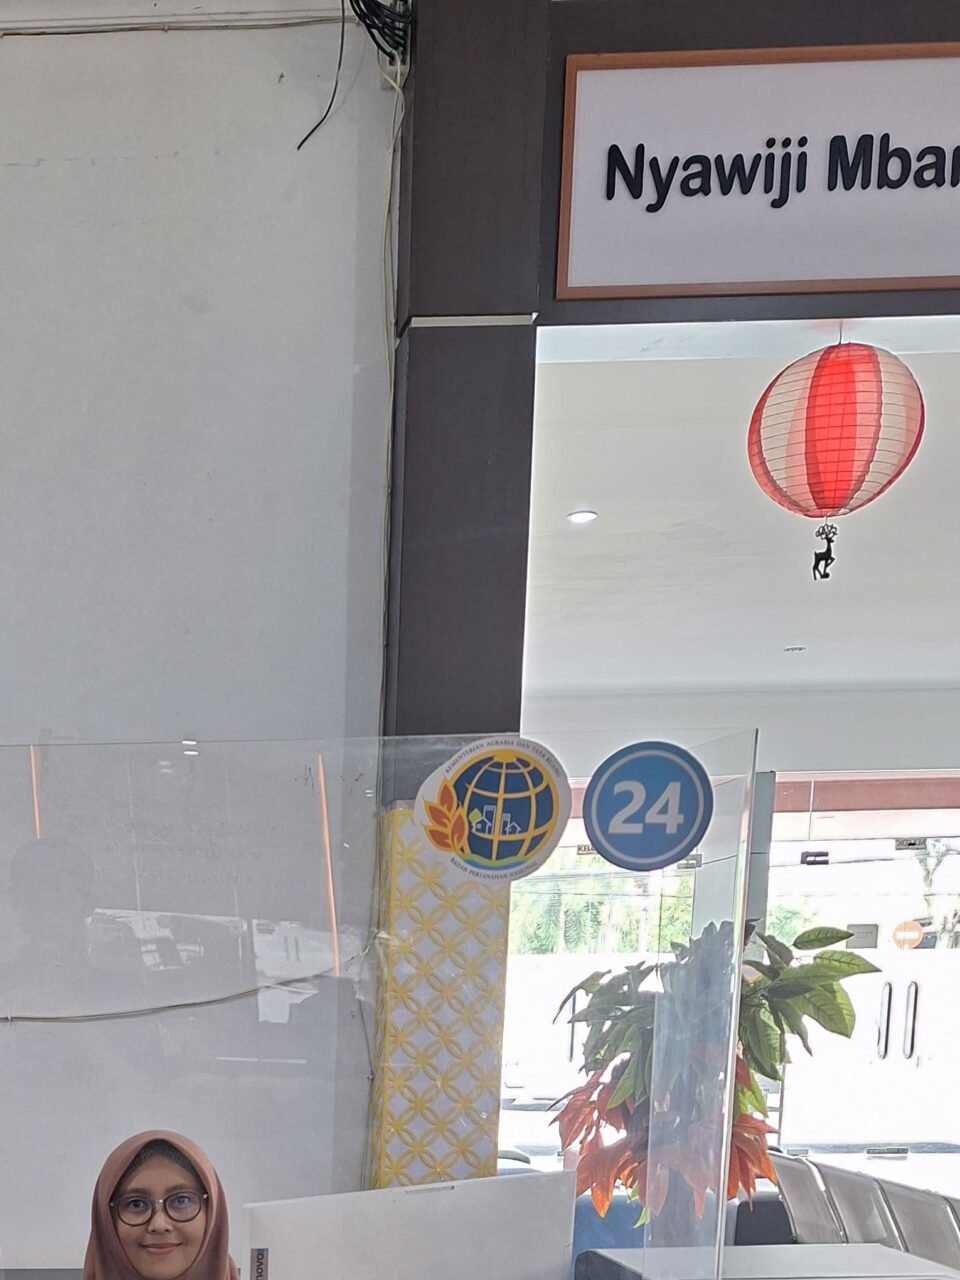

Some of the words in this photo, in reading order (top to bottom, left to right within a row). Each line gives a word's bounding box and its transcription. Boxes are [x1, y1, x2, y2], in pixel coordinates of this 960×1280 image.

[605, 136, 809, 213] Nyawiji
[827, 132, 960, 192] Mba
[486, 739, 515, 748] AGRARIA
[516, 739, 530, 749] DAN
[531, 745, 545, 758] TATA
[608, 780, 685, 834] 24
[450, 857, 468, 873] BADAN
[468, 869, 508, 880] PERTANAHAN
